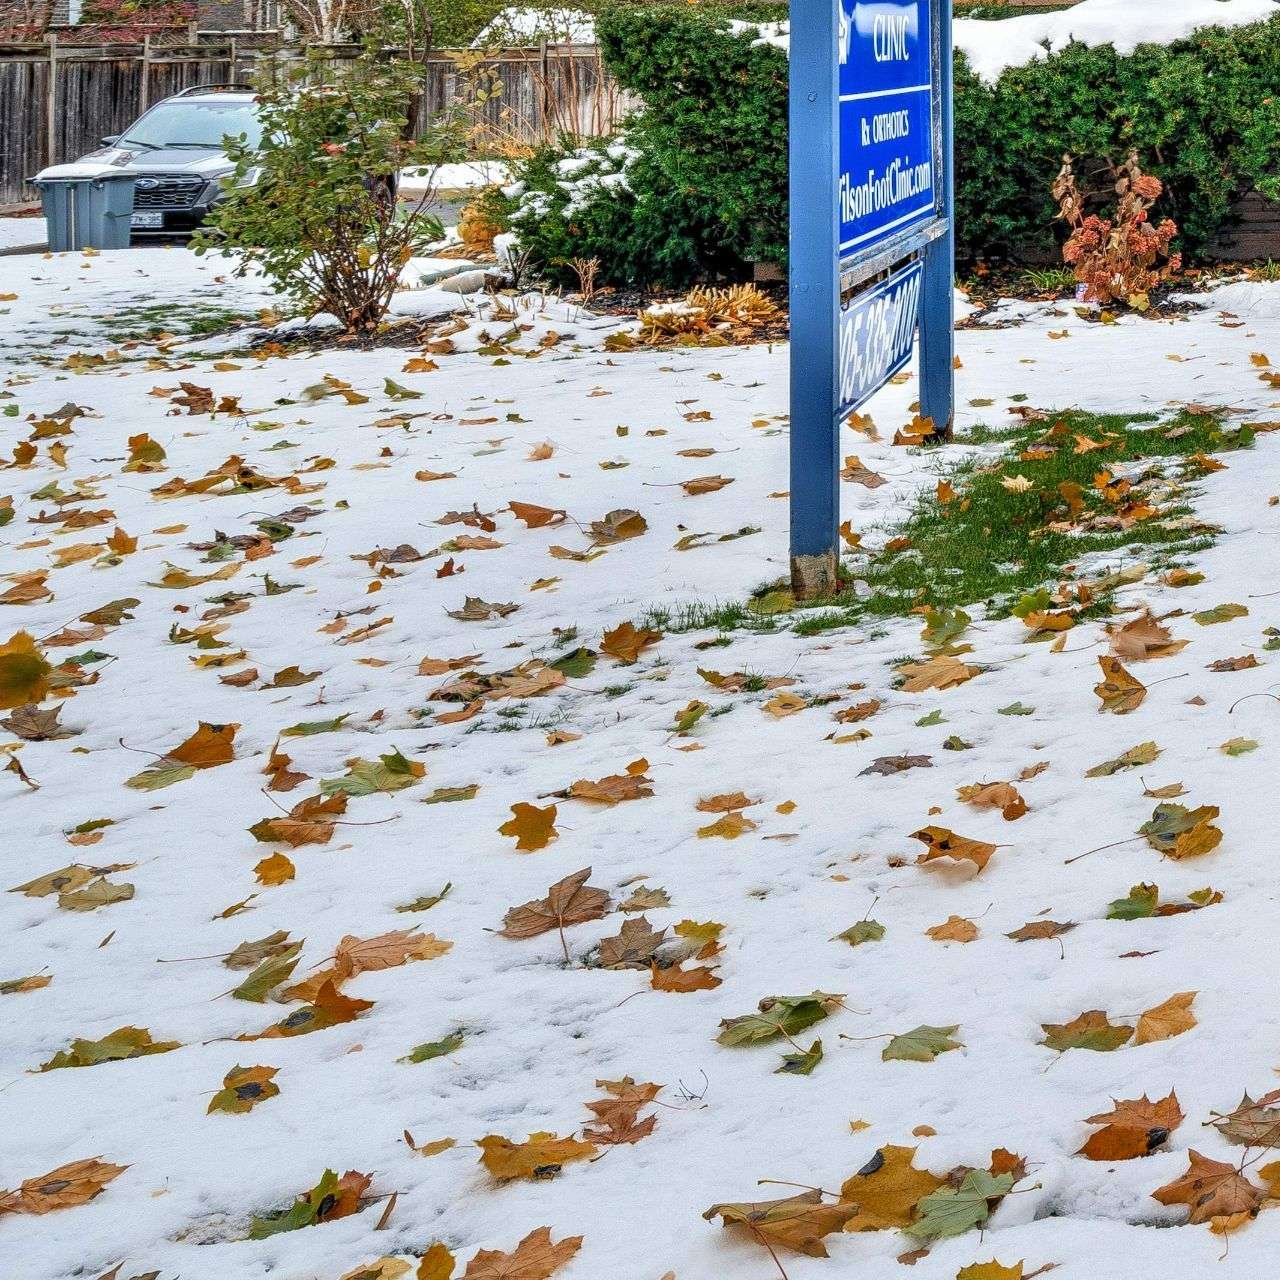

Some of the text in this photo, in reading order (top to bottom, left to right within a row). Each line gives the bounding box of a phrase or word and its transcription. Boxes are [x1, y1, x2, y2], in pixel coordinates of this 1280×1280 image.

[873, 14, 909, 62] CLINIC
[873, 110, 909, 143] ORTHOTICS
[839, 155, 931, 224] ilsonFootClinic.com
[839, 271, 920, 406] 05-335-2000
